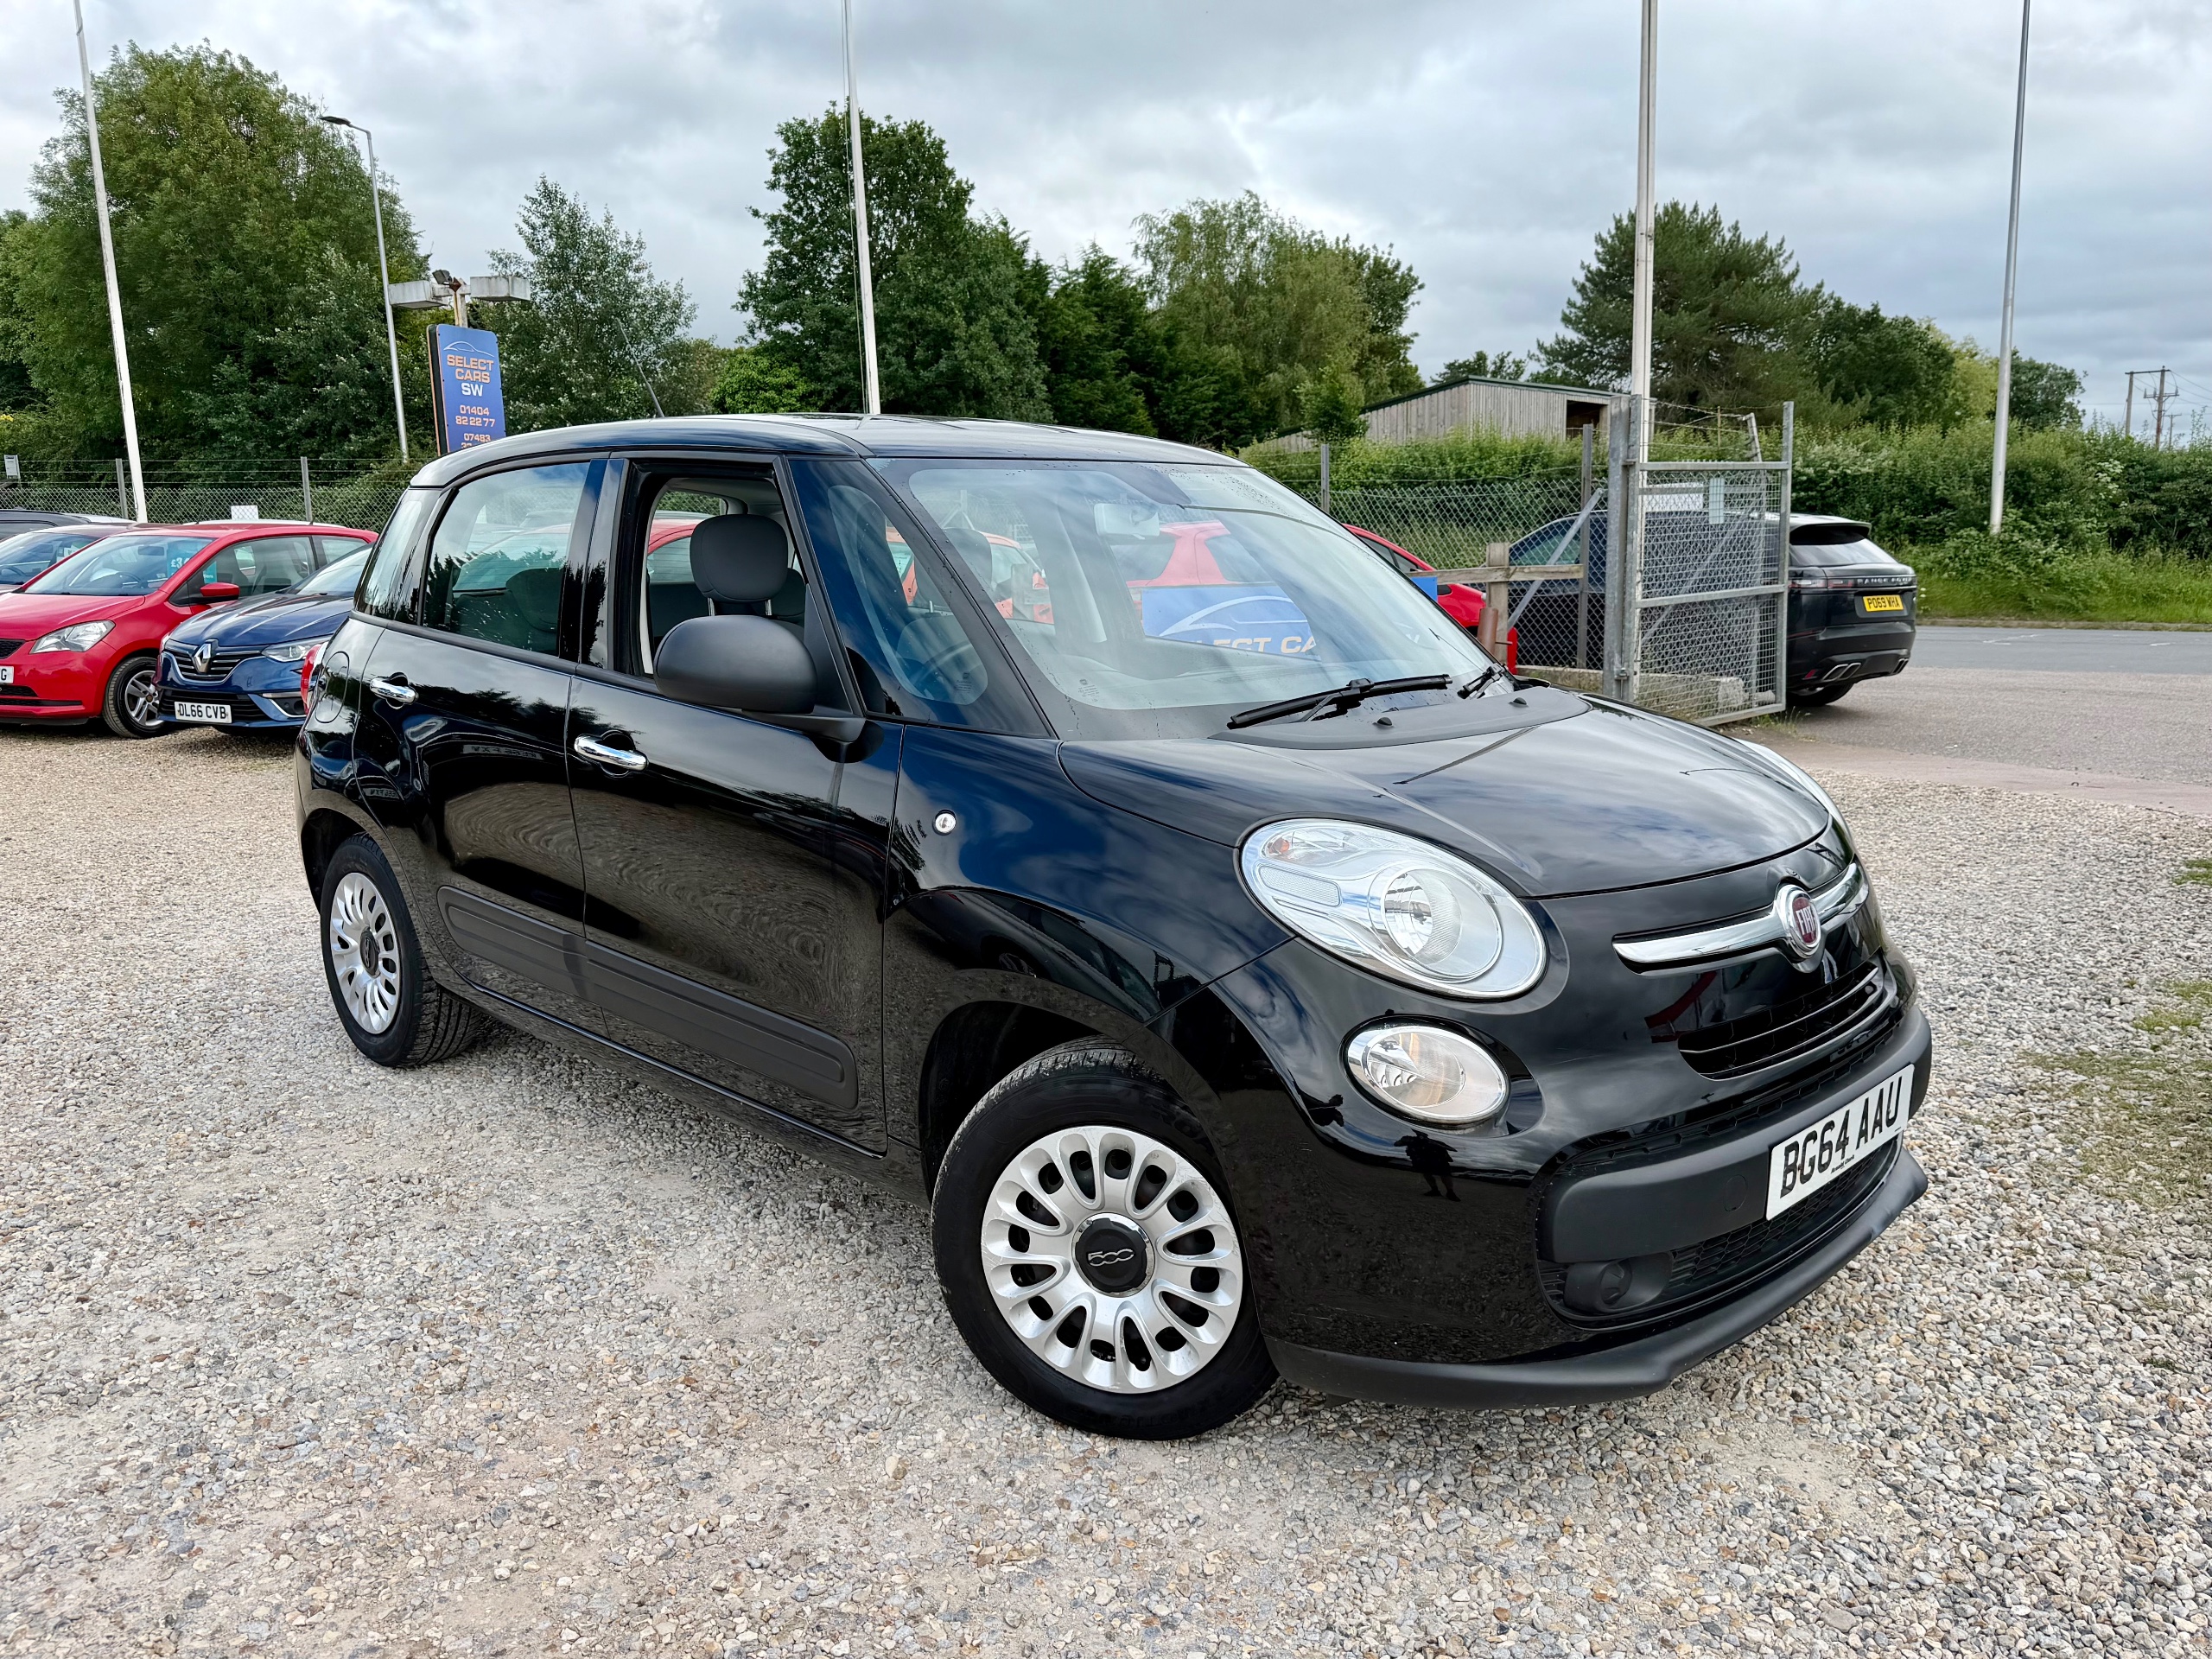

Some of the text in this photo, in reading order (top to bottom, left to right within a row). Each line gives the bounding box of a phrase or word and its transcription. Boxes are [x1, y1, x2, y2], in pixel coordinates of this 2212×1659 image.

[447, 354, 494, 371] SELECT
[455, 369, 491, 384] CARS
[461, 383, 484, 397] SW
[460, 404, 490, 416] 01404
[463, 433, 491, 442] 07483
[178, 703, 226, 719] DL66 CVB
[1780, 1075, 1903, 1199] BG64 AAU
[1087, 1249, 1135, 1267] 500
